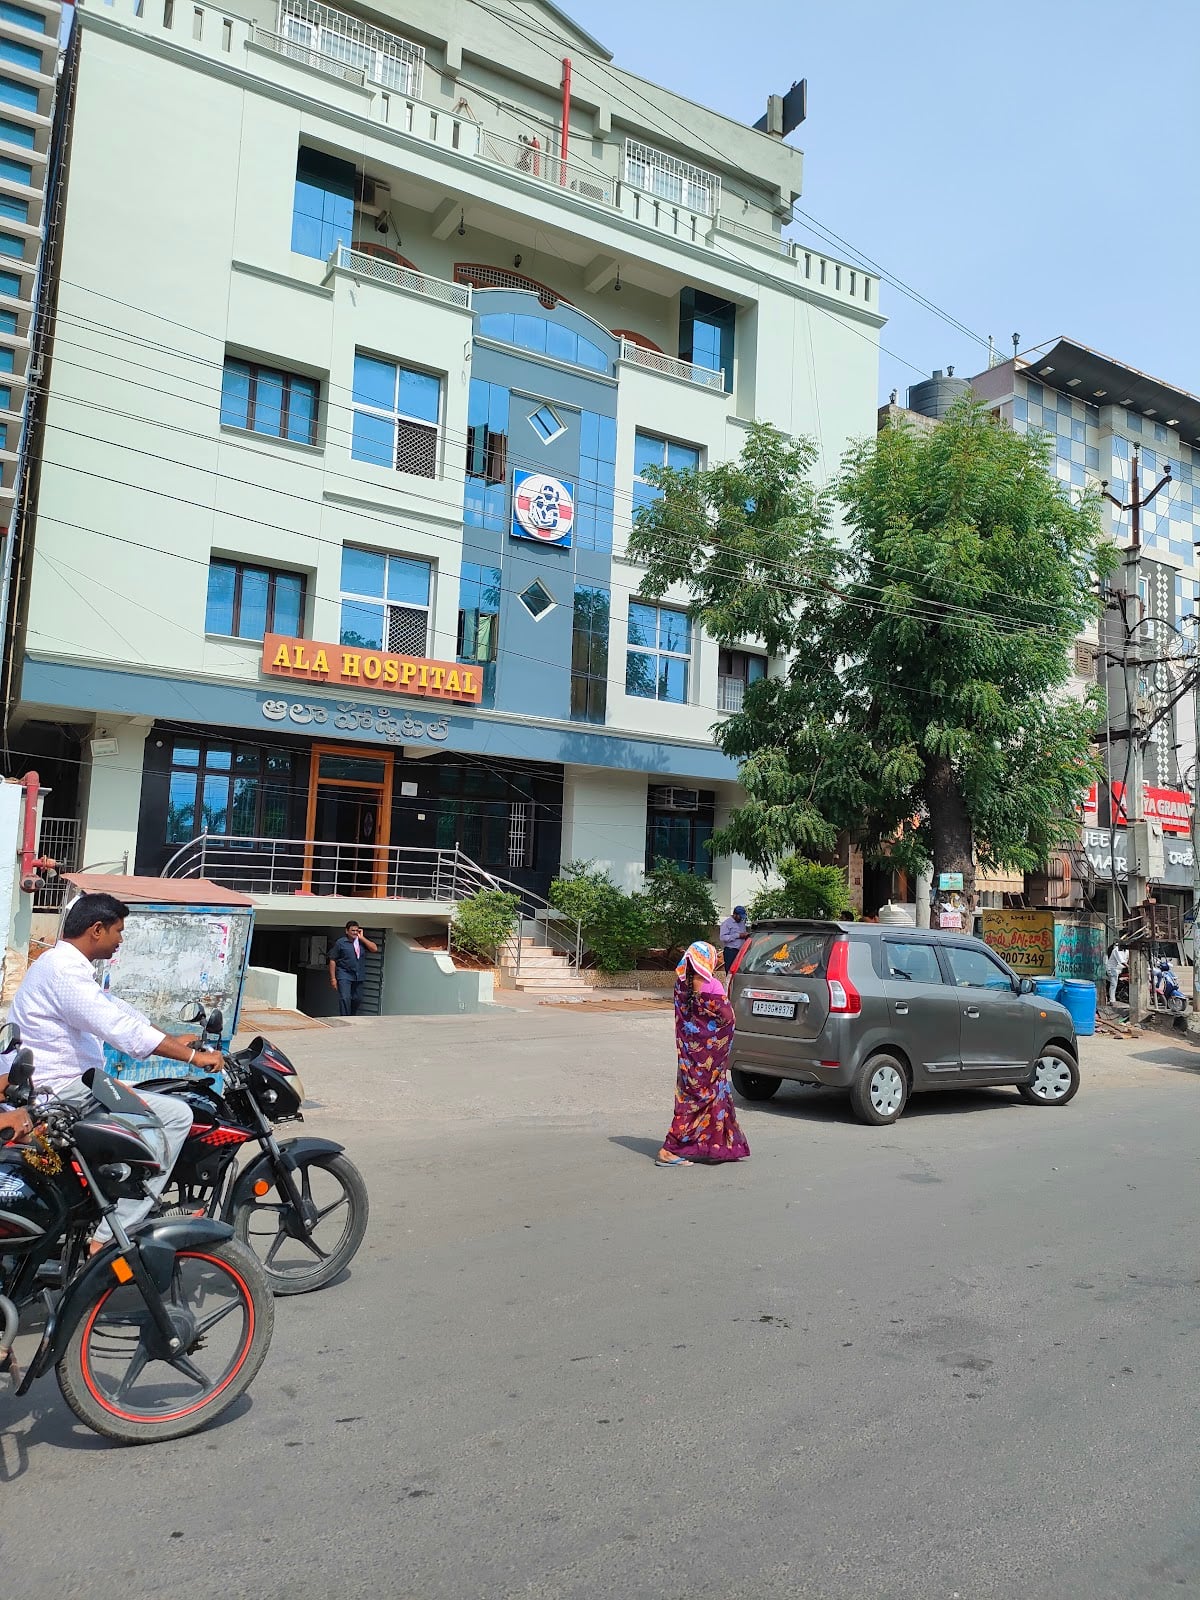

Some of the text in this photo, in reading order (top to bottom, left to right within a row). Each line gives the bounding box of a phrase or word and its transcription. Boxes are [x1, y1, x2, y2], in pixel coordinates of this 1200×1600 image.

[272, 643, 478, 694] ALA HOSPITAL
[262, 699, 329, 724] ఆలా
